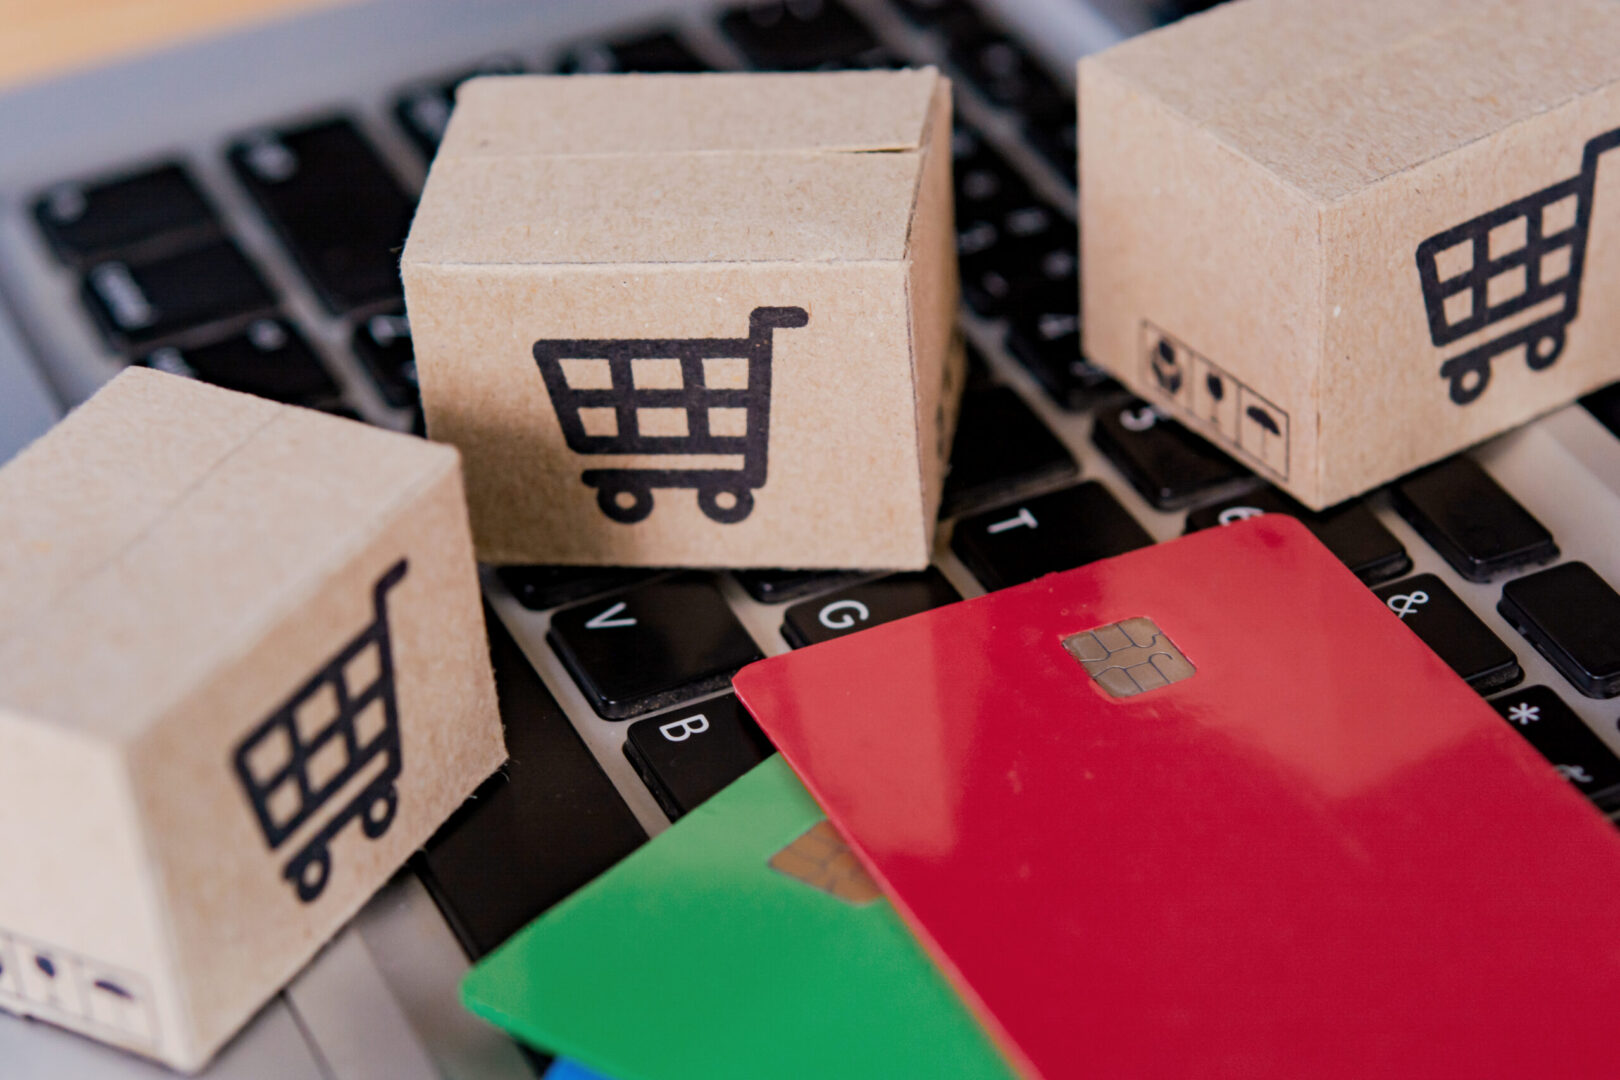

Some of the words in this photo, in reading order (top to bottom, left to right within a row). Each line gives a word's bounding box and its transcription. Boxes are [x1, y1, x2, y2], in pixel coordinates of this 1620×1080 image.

[987, 508, 1038, 534] T
[585, 602, 637, 629] V
[818, 599, 870, 630] G
[1386, 590, 1430, 619] &
[658, 713, 710, 743] B
